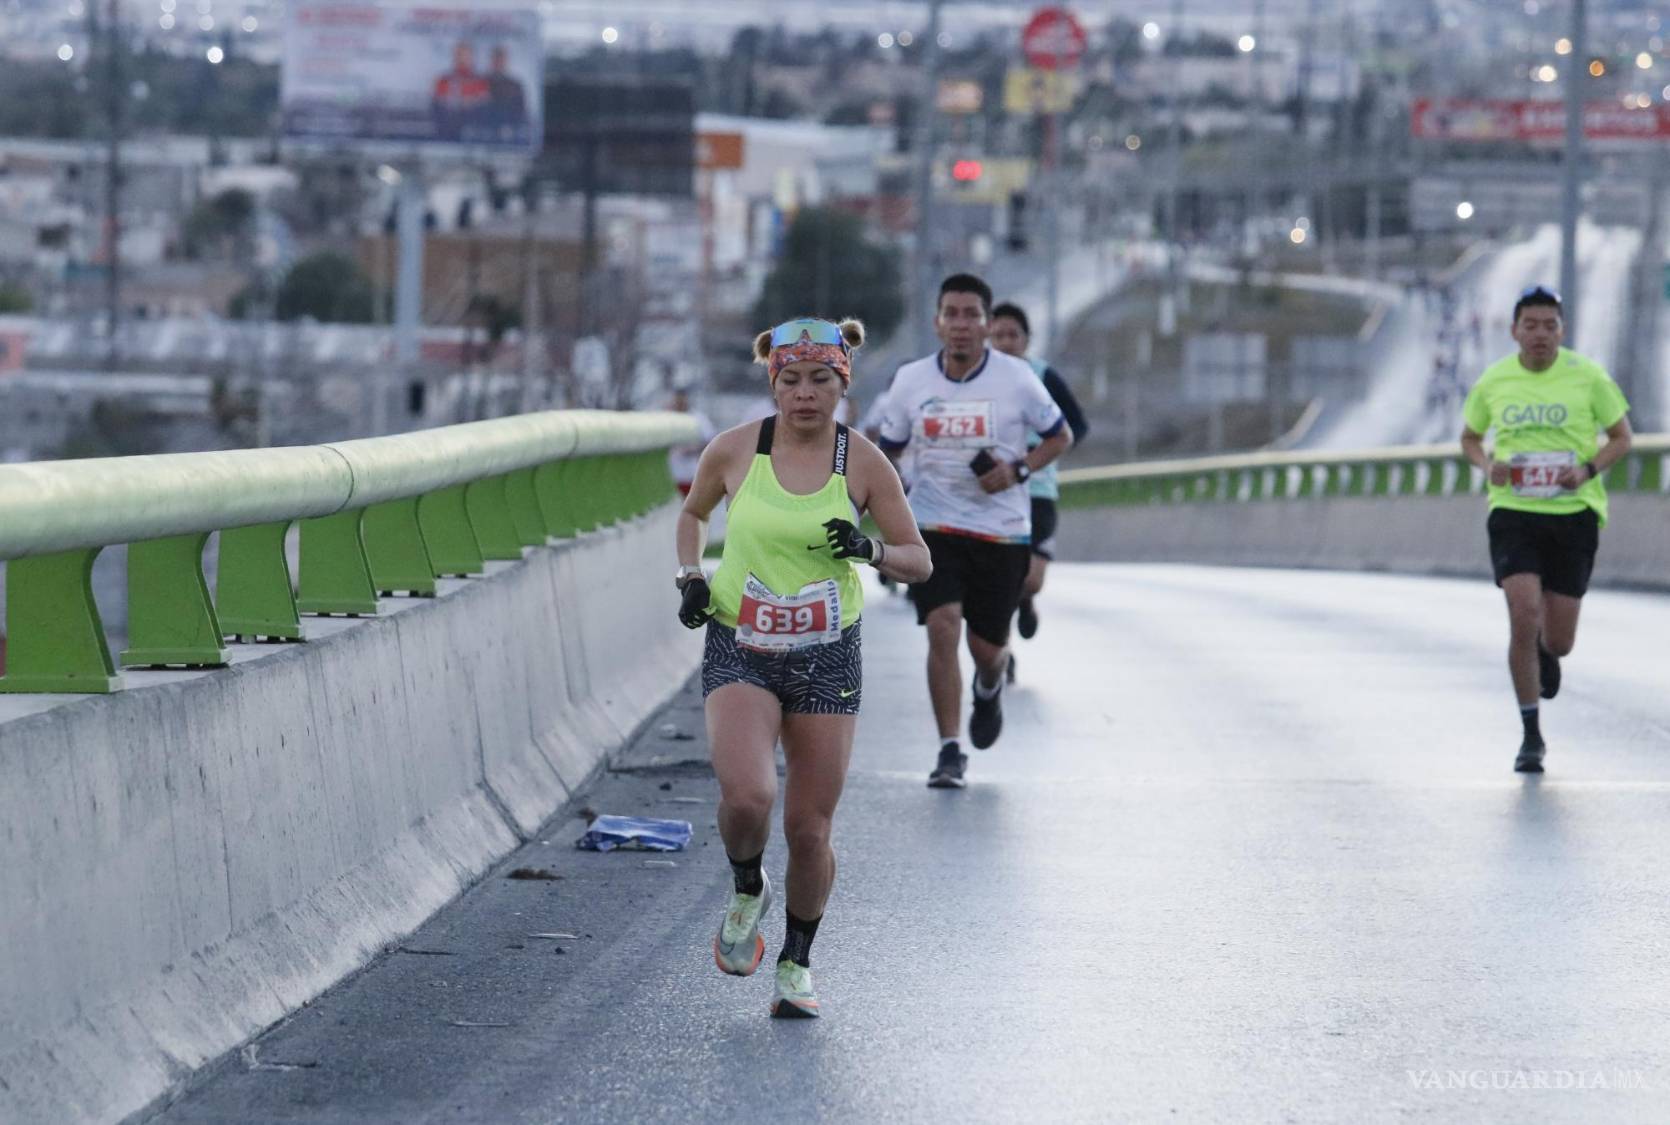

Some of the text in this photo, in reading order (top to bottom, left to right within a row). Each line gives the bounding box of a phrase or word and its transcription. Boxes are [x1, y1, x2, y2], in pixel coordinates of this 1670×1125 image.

[938, 417, 976, 435] 262
[1503, 404, 1567, 425] GATO
[756, 604, 813, 632] 639
[827, 581, 840, 632] Medalla
